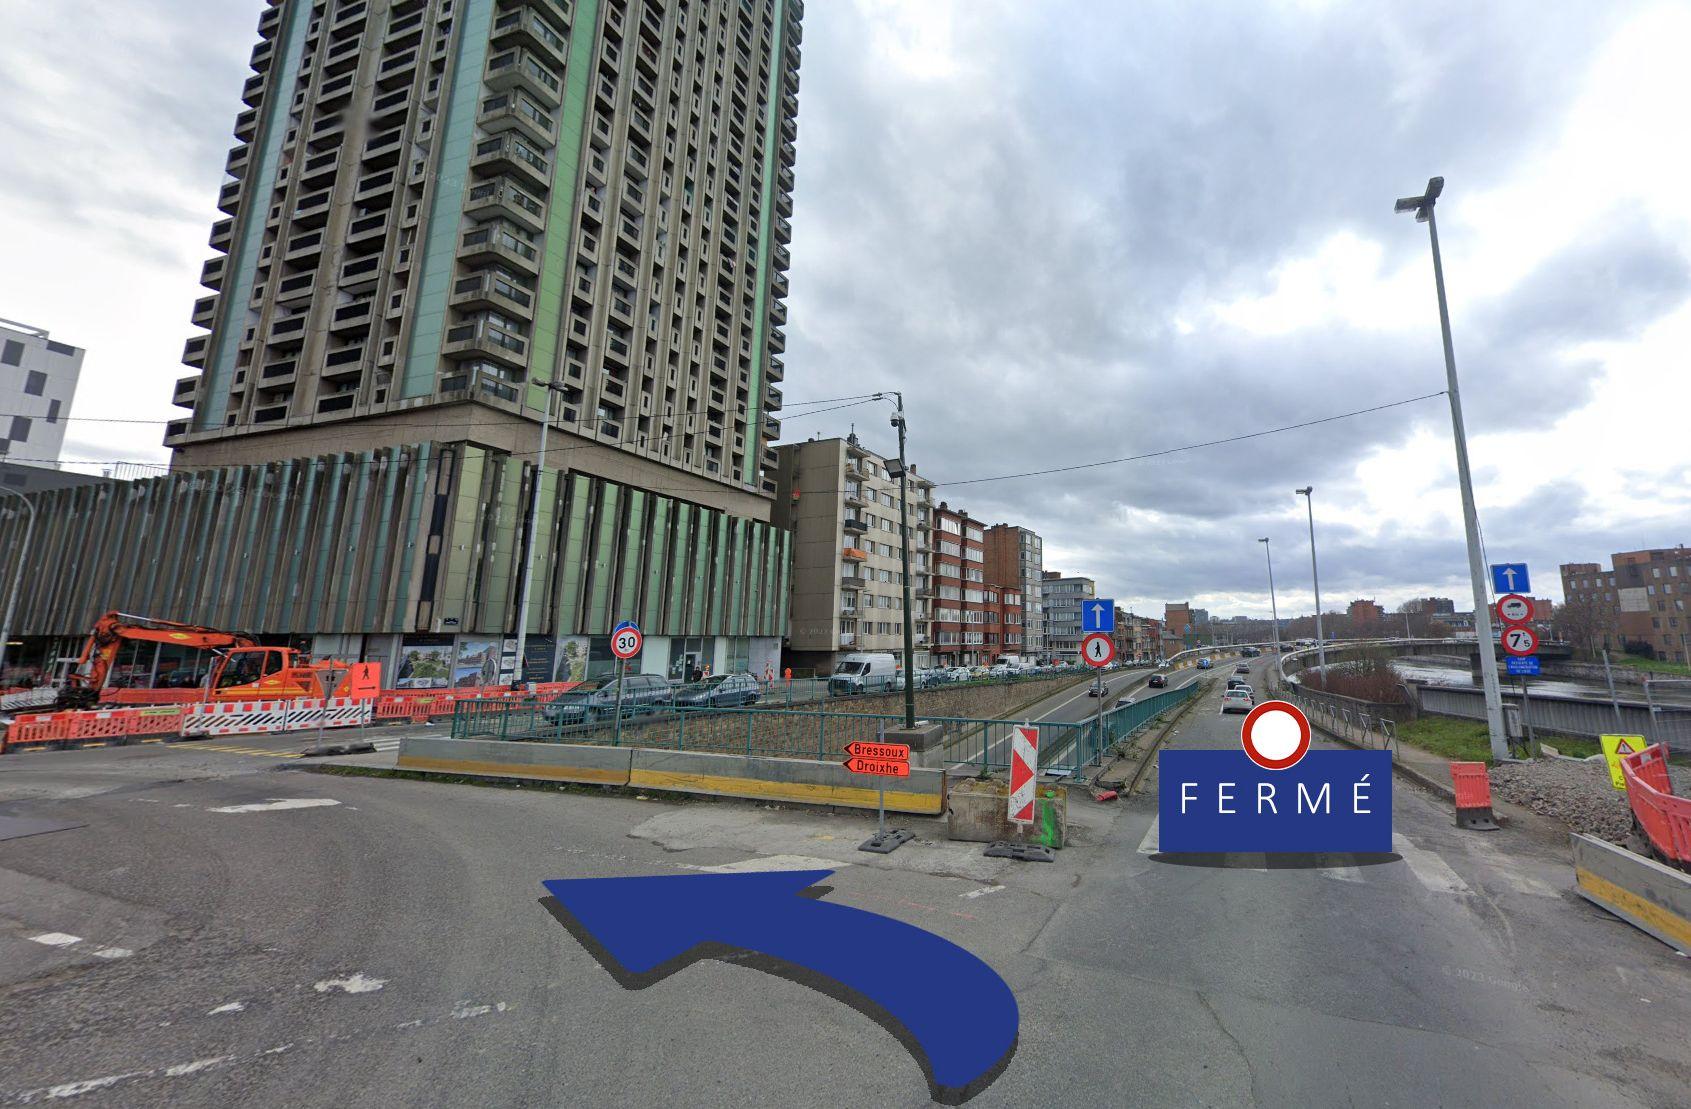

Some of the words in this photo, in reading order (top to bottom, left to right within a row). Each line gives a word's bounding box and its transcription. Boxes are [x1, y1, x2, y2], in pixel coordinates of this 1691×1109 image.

[618, 636, 636, 649] 30
[854, 743, 905, 758] Bressoux
[856, 760, 899, 774] Droixhe
